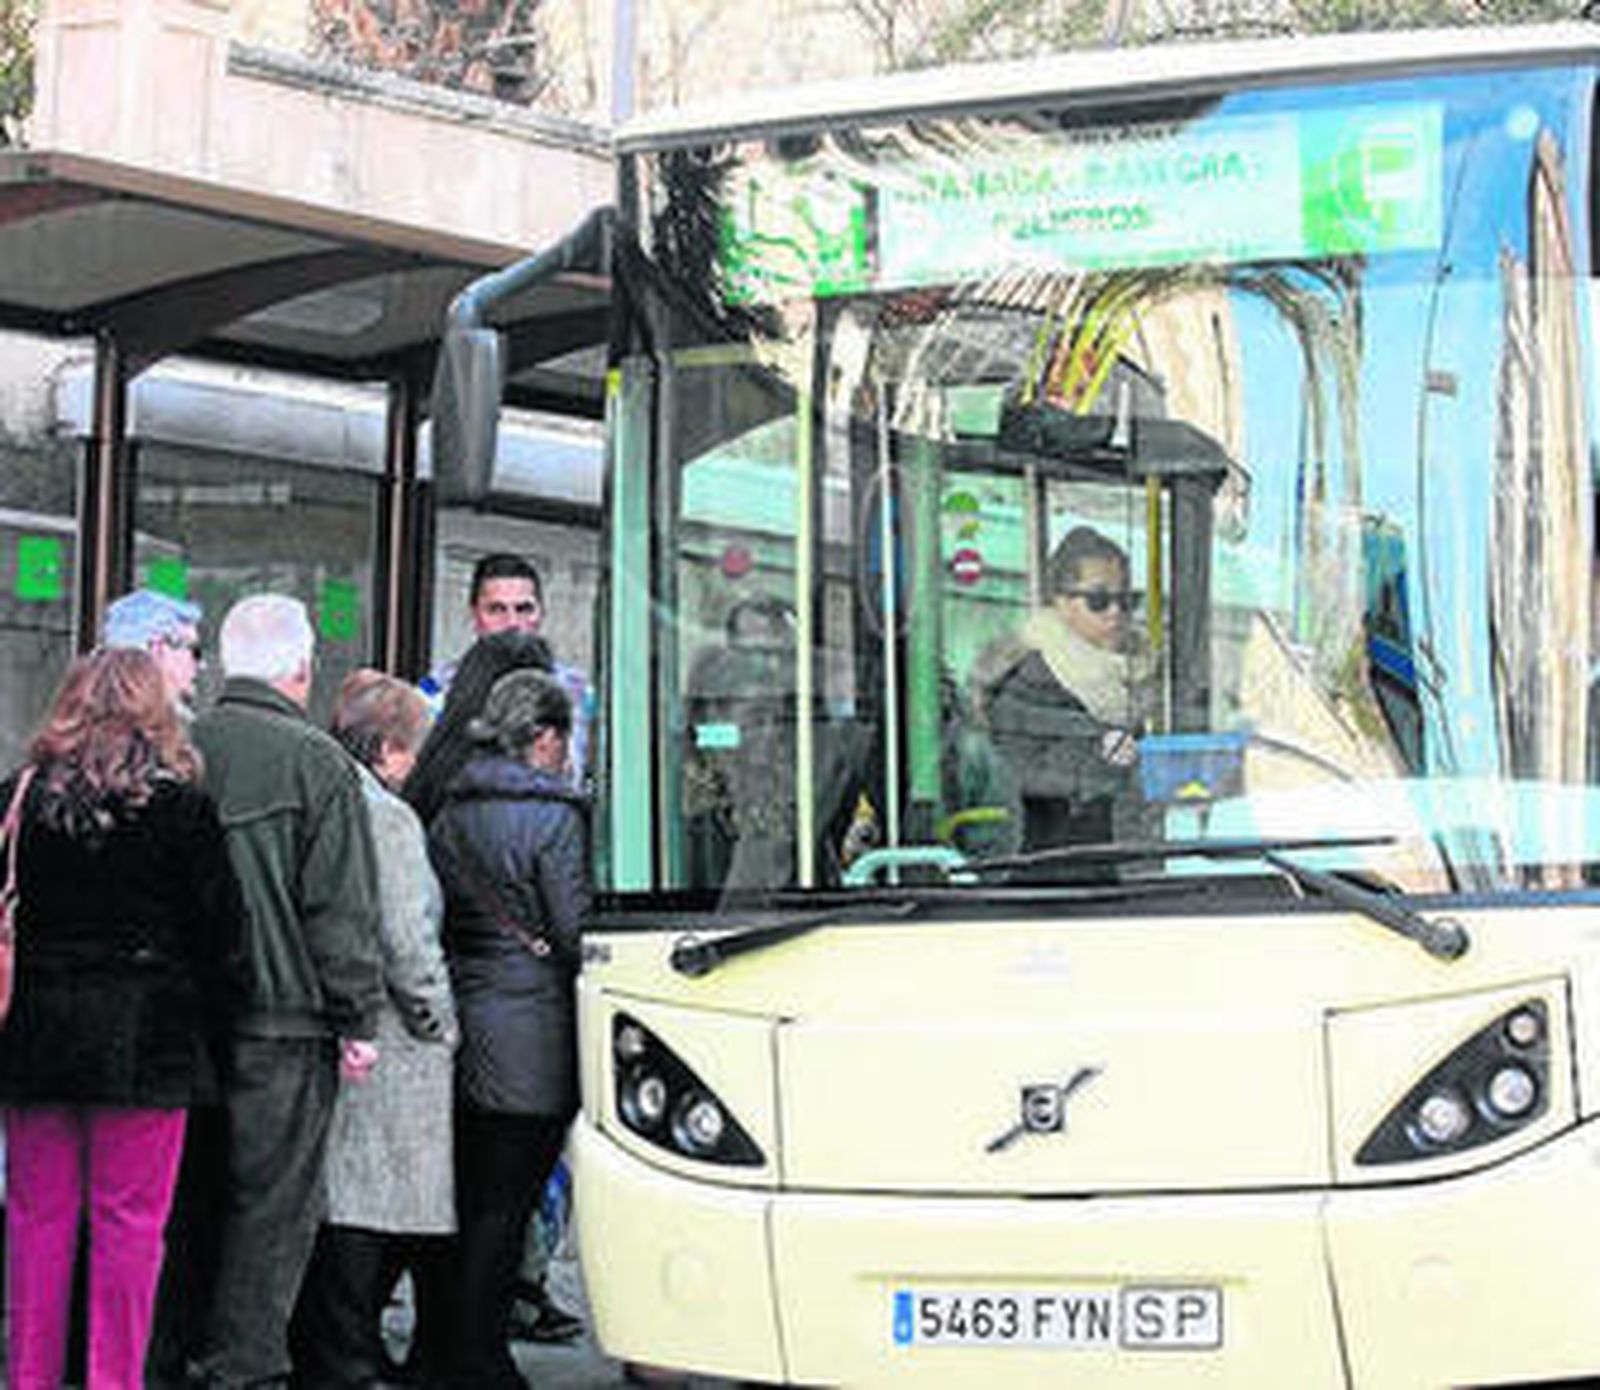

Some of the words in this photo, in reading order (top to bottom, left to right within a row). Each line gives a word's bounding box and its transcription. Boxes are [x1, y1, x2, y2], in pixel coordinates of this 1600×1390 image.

[919, 1297, 1020, 1339] 5463
[1032, 1297, 1111, 1339] FYN
[1133, 1295, 1207, 1340] SP
